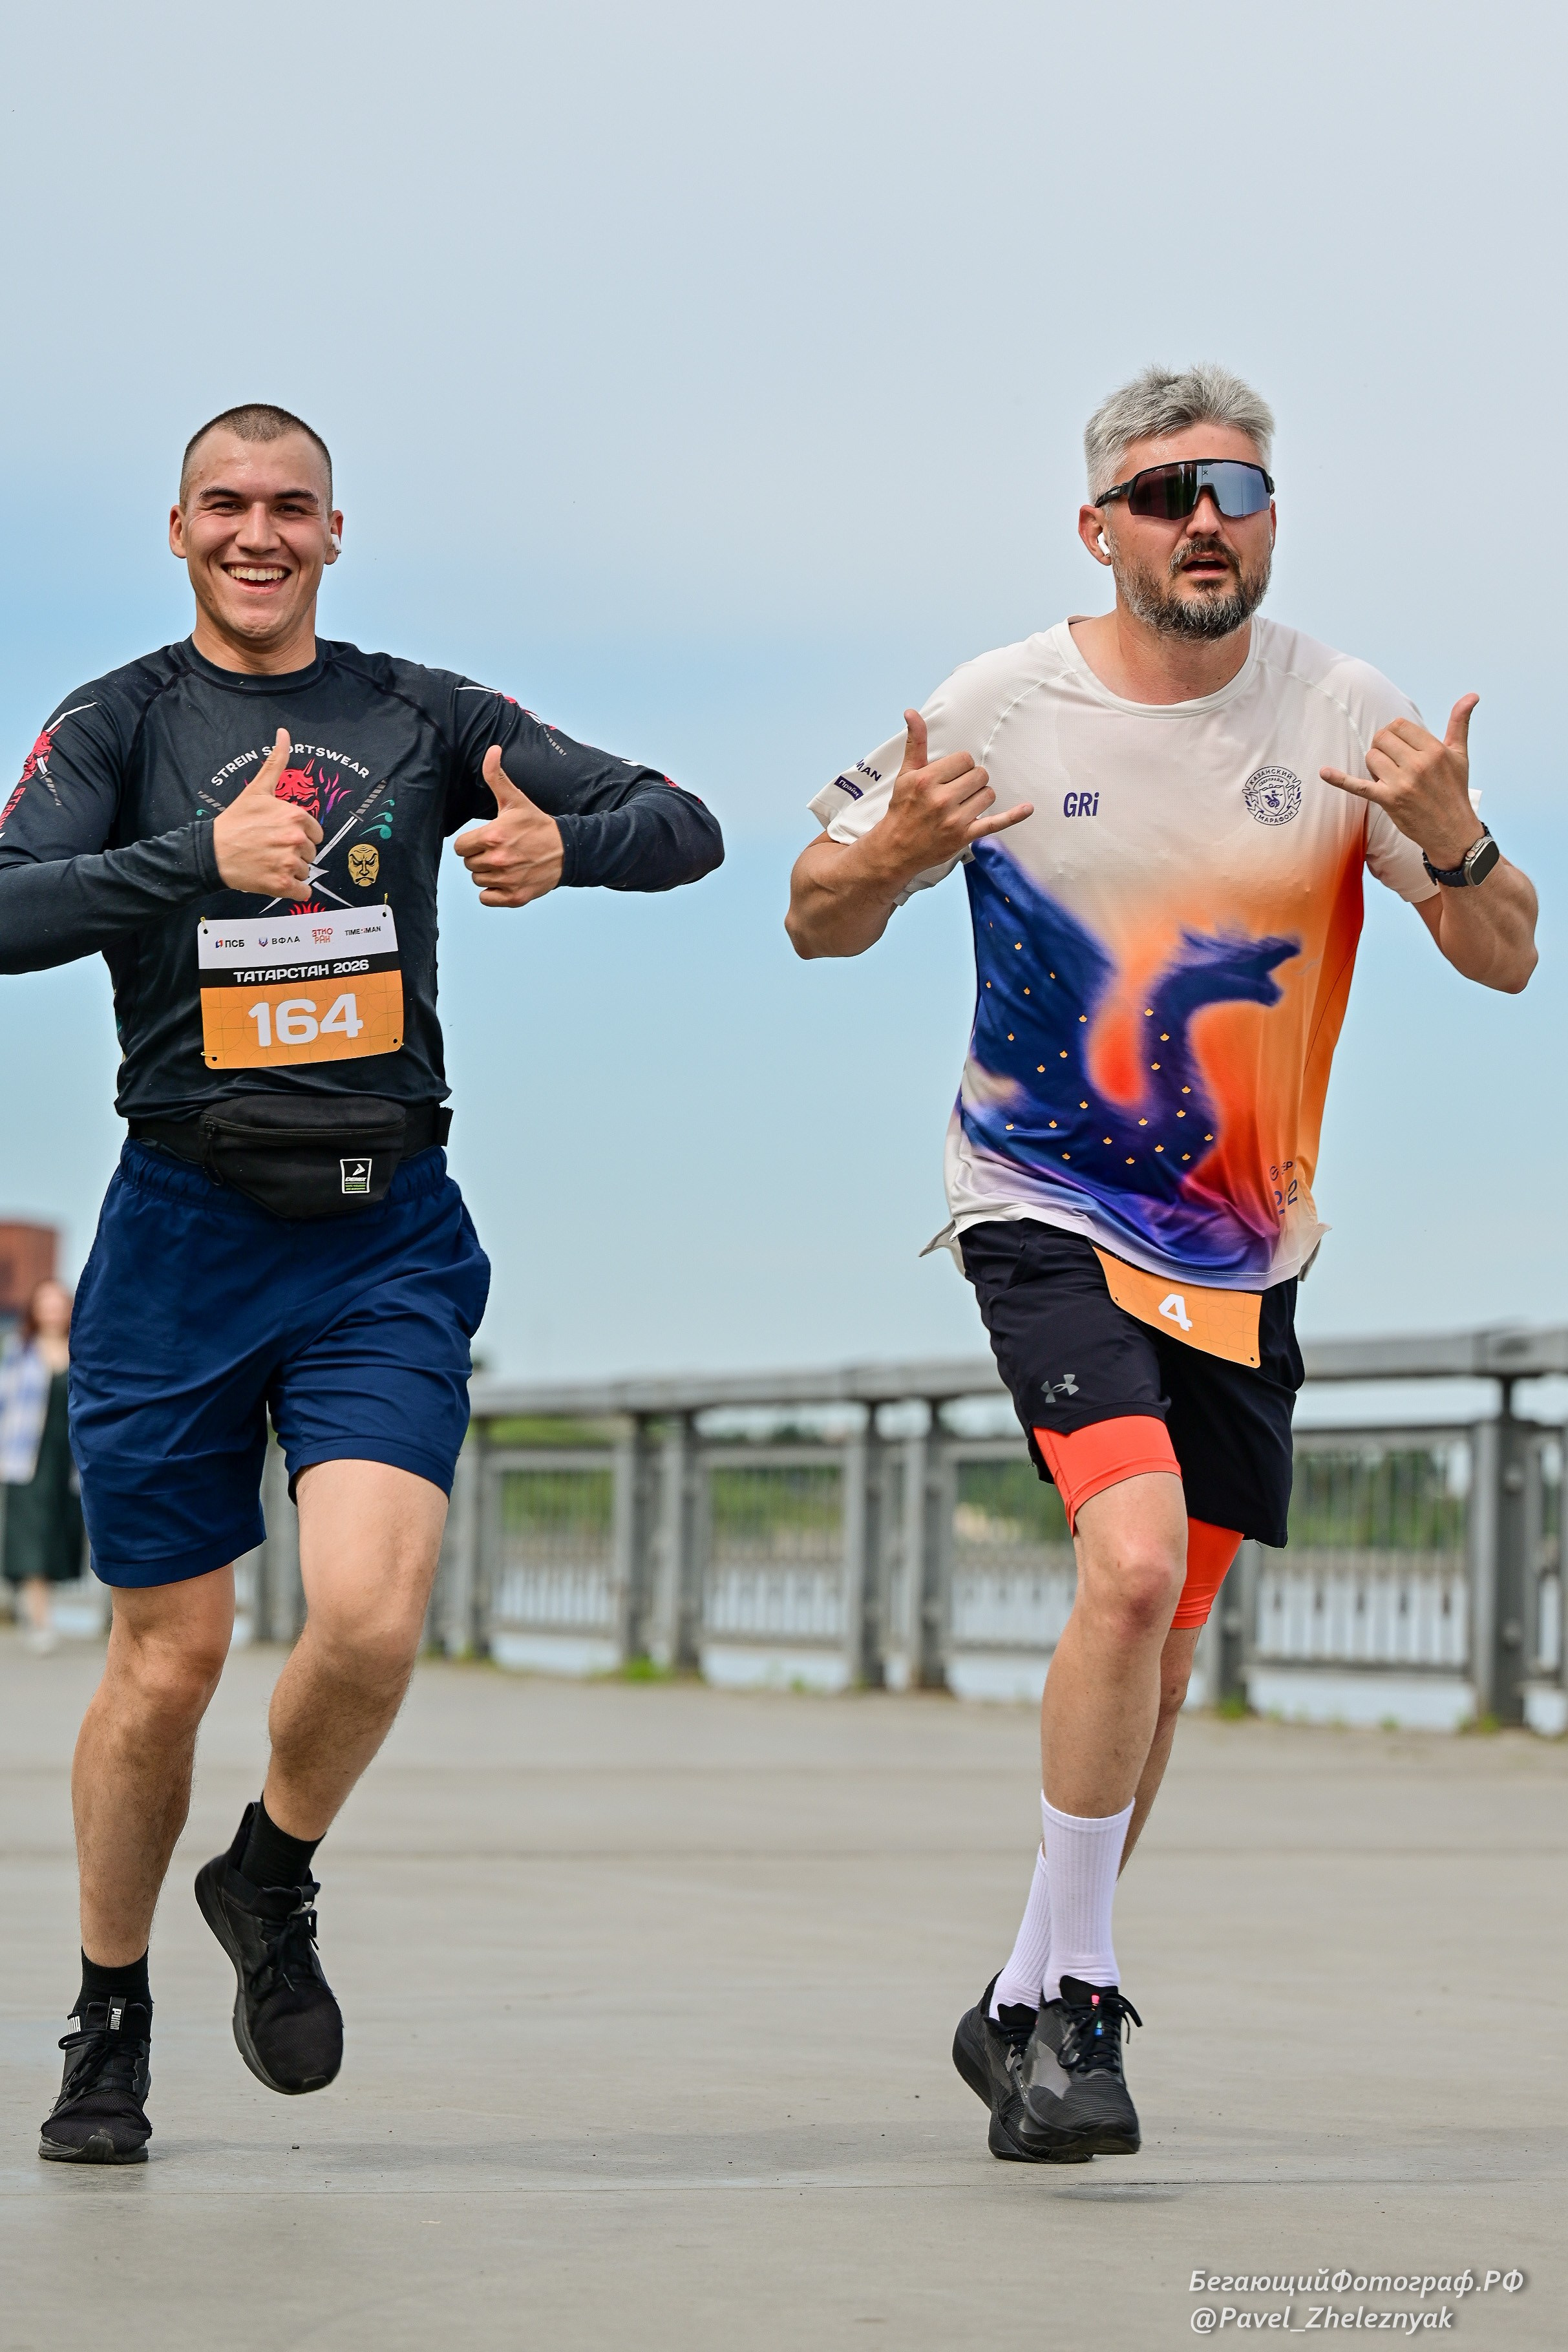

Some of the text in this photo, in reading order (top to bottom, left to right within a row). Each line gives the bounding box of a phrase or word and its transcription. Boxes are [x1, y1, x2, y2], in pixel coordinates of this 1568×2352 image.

[211, 743, 370, 786] STREIN SRTSWEAR
[1250, 769, 1293, 785] КАЗАНСКИЙ
[839, 779, 860, 798] Прайм
[1063, 792, 1099, 818] GRi
[1258, 810, 1294, 823] МАРАФОН
[225, 939, 245, 948] ПСБ
[271, 935, 301, 945] ВФЛА
[233, 959, 370, 982] ТАТАРСТАН 2026
[248, 993, 364, 1047] 164
[110, 2008, 122, 2030] PUMA
